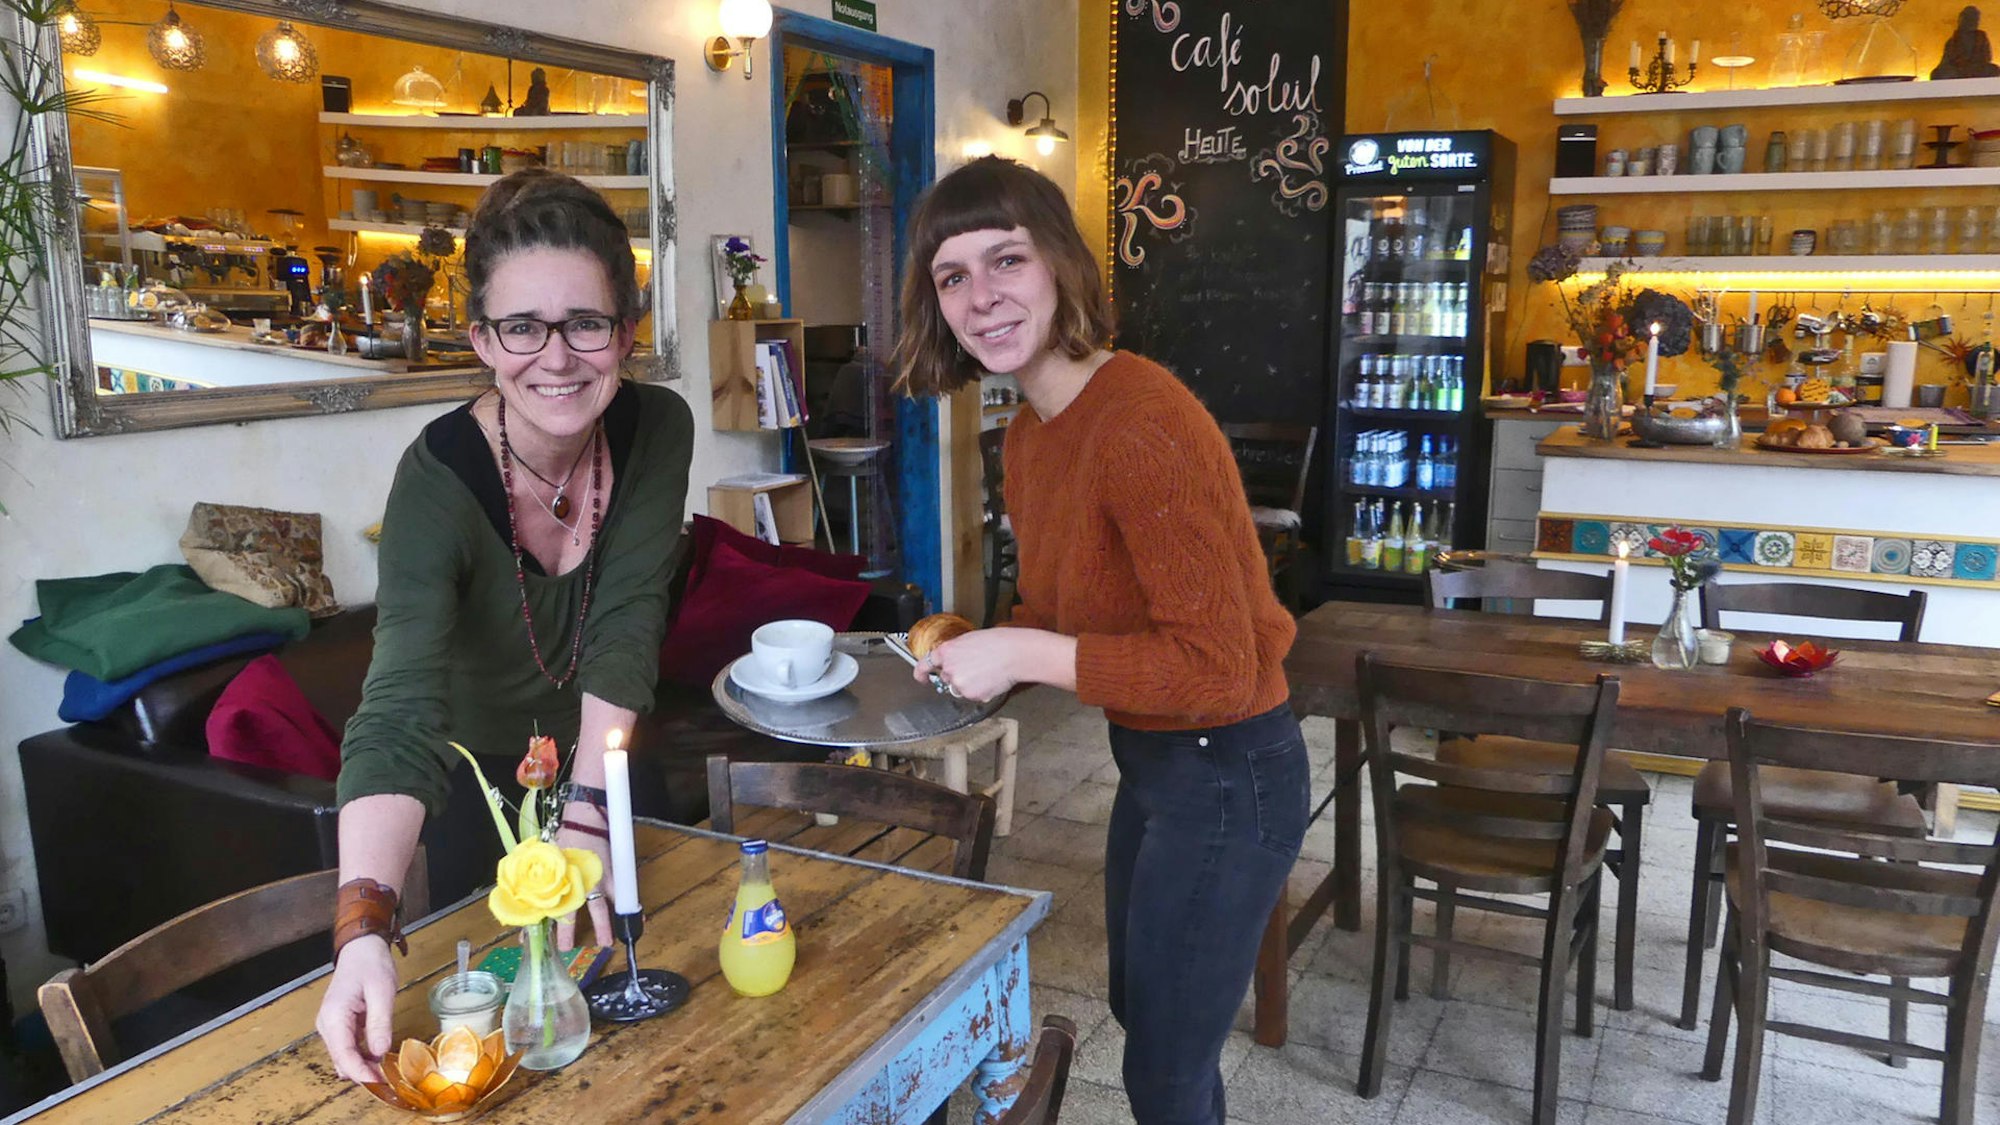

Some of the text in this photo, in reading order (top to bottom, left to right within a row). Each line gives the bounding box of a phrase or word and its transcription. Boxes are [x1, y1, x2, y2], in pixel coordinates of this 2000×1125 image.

[834, 1, 874, 25] Notausgang
[1171, 12, 1243, 92] café
[1223, 52, 1323, 116] soleil
[1397, 138, 1451, 153] VON DER
[1388, 153, 1429, 175] guten
